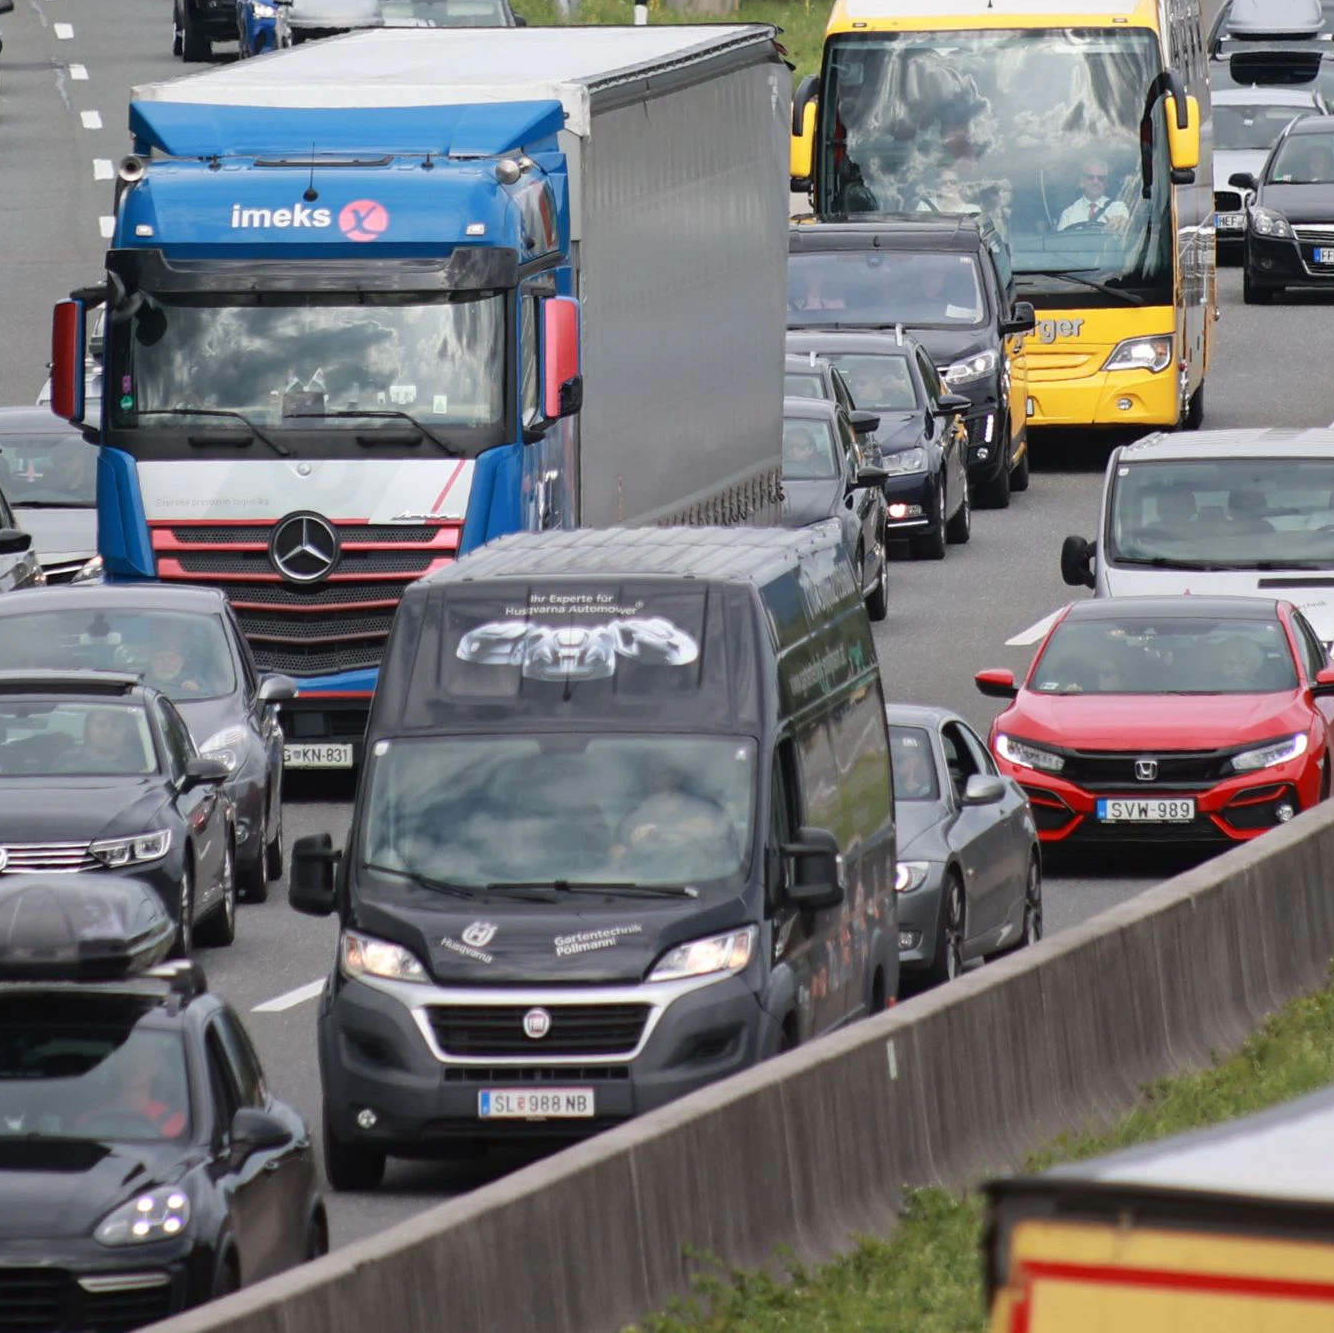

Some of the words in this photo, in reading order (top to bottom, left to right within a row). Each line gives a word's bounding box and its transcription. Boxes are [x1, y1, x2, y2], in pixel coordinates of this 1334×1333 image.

[231, 203, 333, 228] imeks
[530, 594, 546, 603] Ihr
[549, 594, 593, 604] Experte
[597, 594, 614, 603] für
[302, 748, 347, 762] KN-831
[1111, 802, 1190, 818] SVW-989
[554, 923, 643, 947] Gartentechnik
[440, 937, 494, 965] Husqvarna
[495, 1095, 514, 1112] SL
[529, 1095, 561, 1112] 988
[566, 1095, 587, 1112] NB
